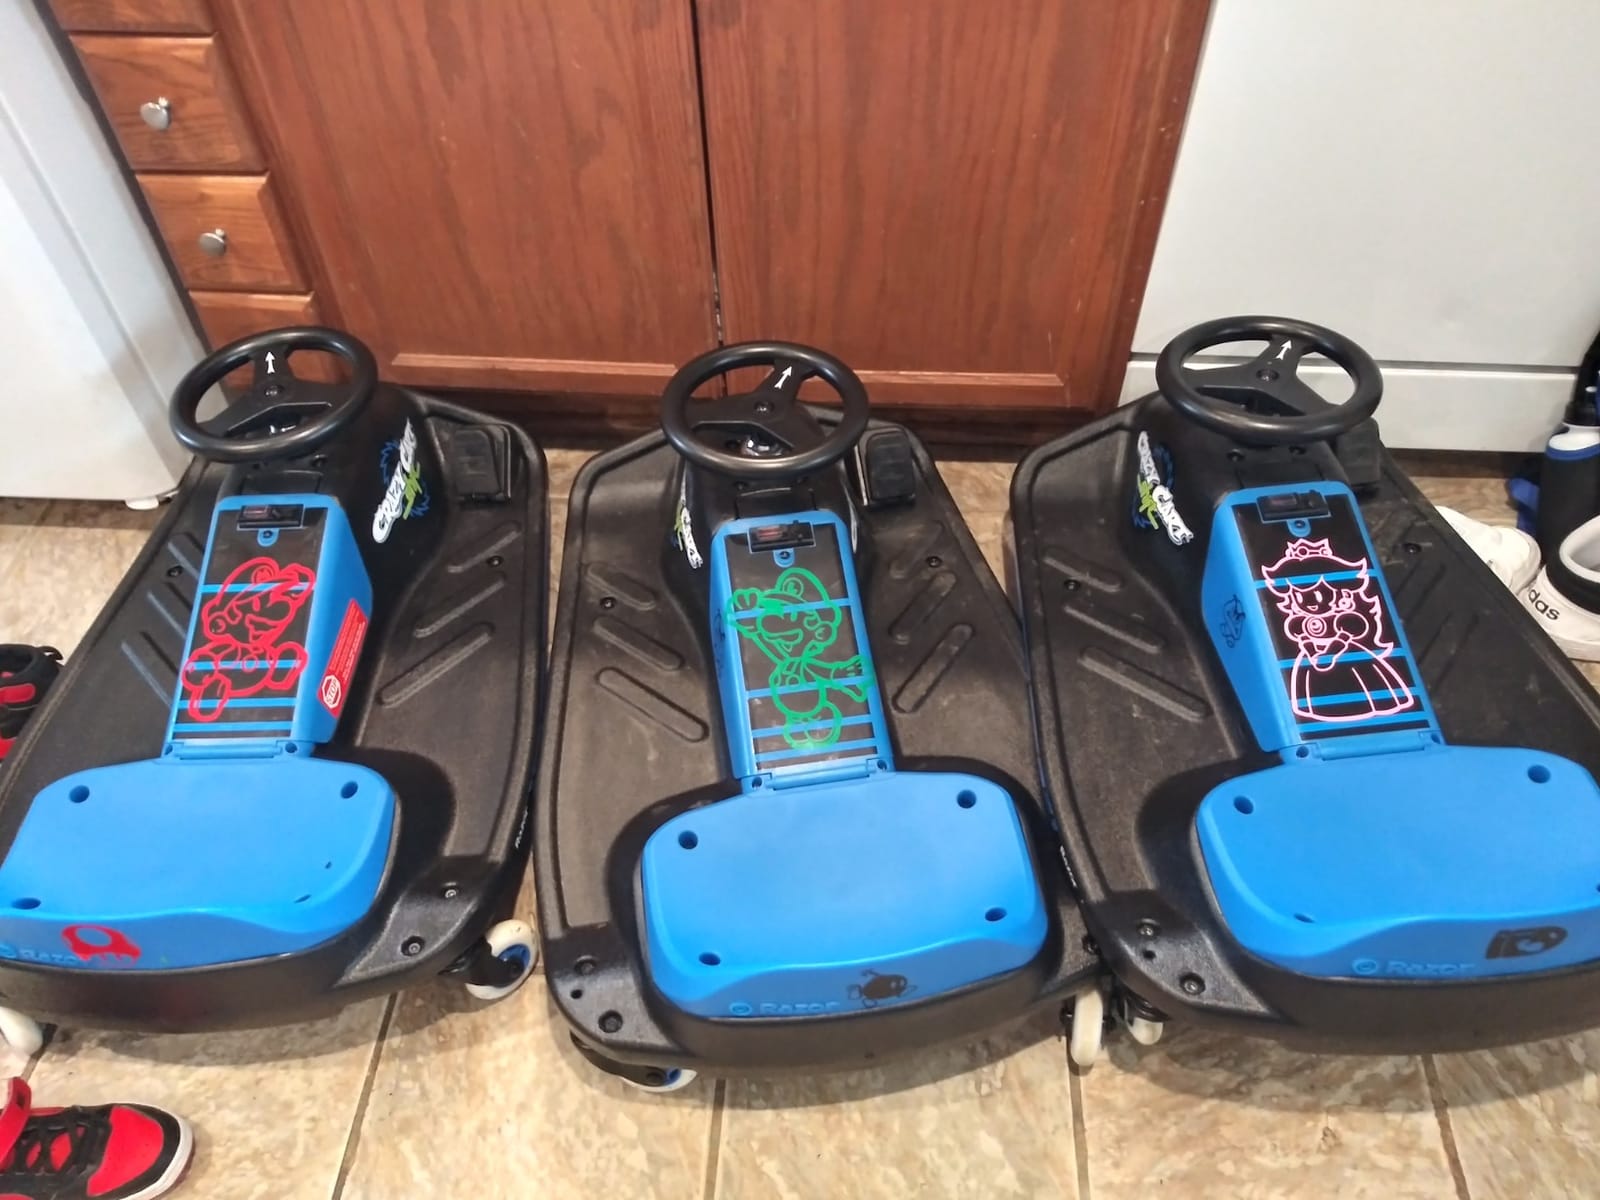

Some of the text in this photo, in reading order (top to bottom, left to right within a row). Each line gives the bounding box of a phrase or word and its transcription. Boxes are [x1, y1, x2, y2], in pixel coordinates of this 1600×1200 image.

[372, 460, 406, 543] CRAZY
[1152, 485, 1194, 546] CART
[1527, 588, 1560, 621] das
[325, 678, 339, 705] STOP
